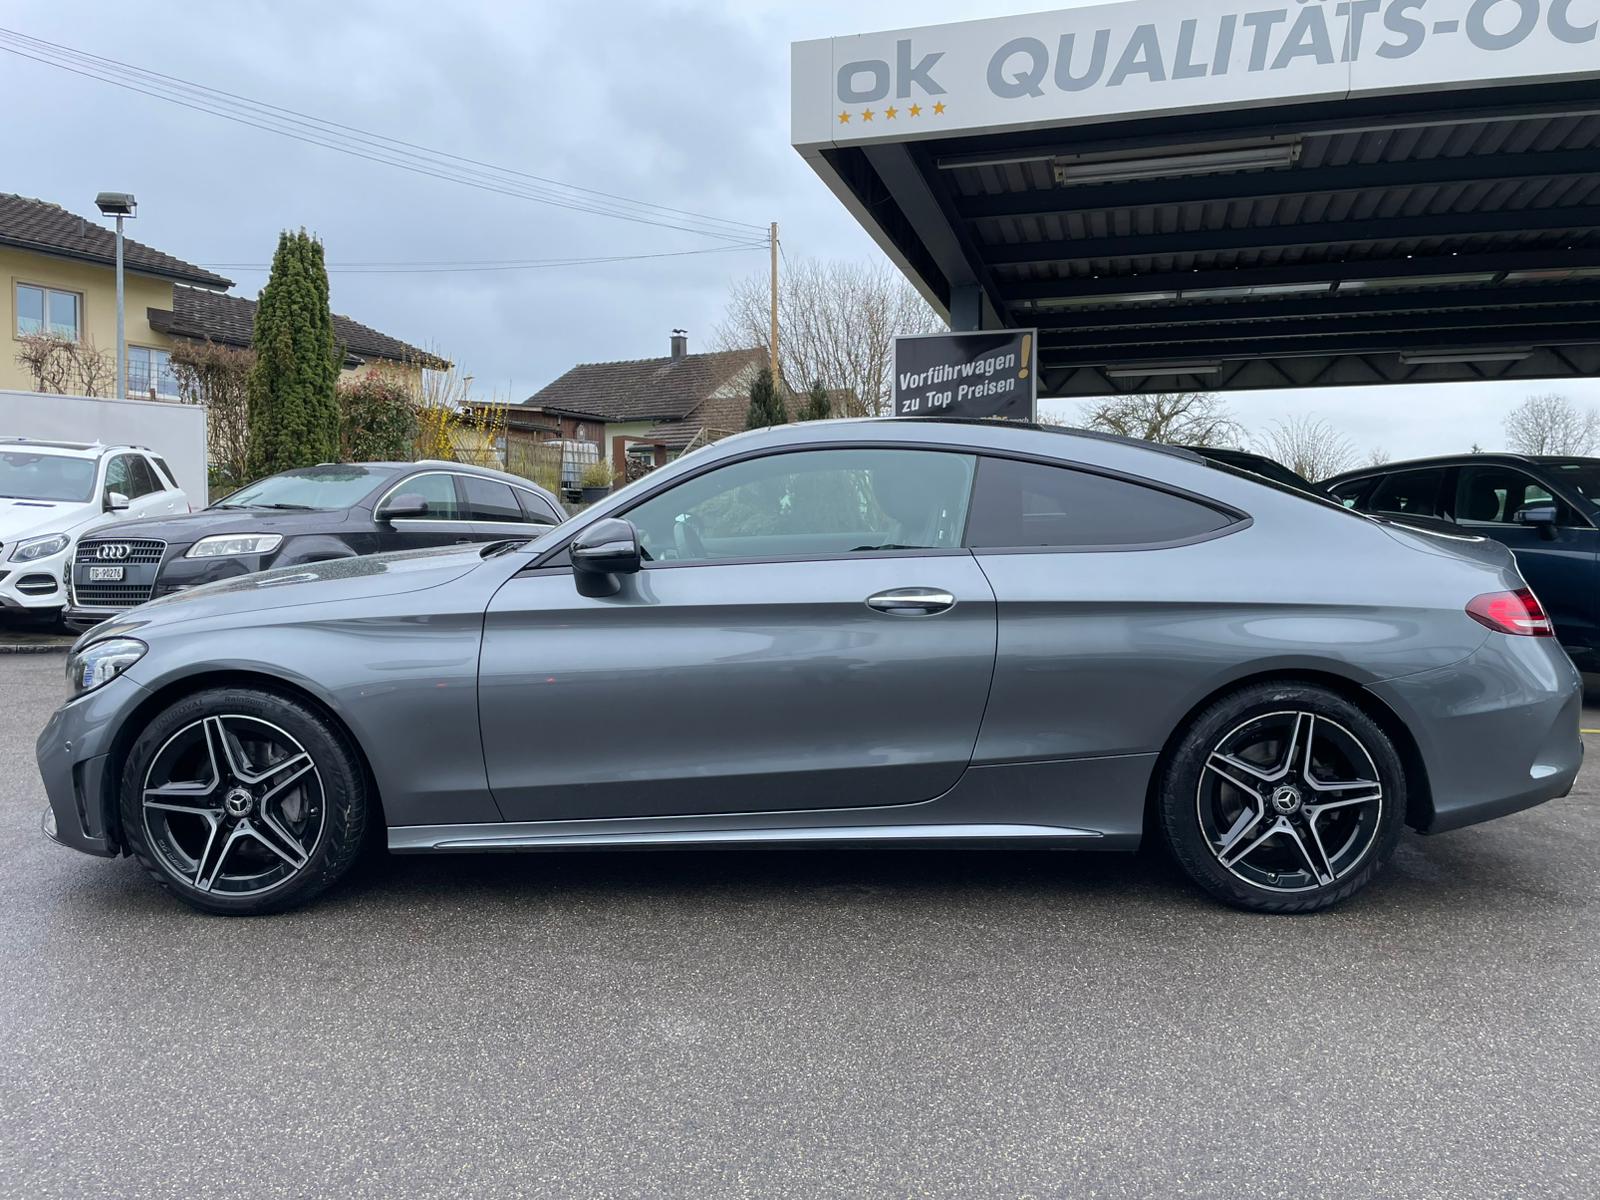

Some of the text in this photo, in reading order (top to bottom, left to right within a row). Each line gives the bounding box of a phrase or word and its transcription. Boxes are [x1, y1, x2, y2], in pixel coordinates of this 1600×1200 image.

[837, 39, 947, 104] ok
[900, 353, 1015, 391] Vorführwagen
[902, 378, 1015, 413] zu Top Preisen
